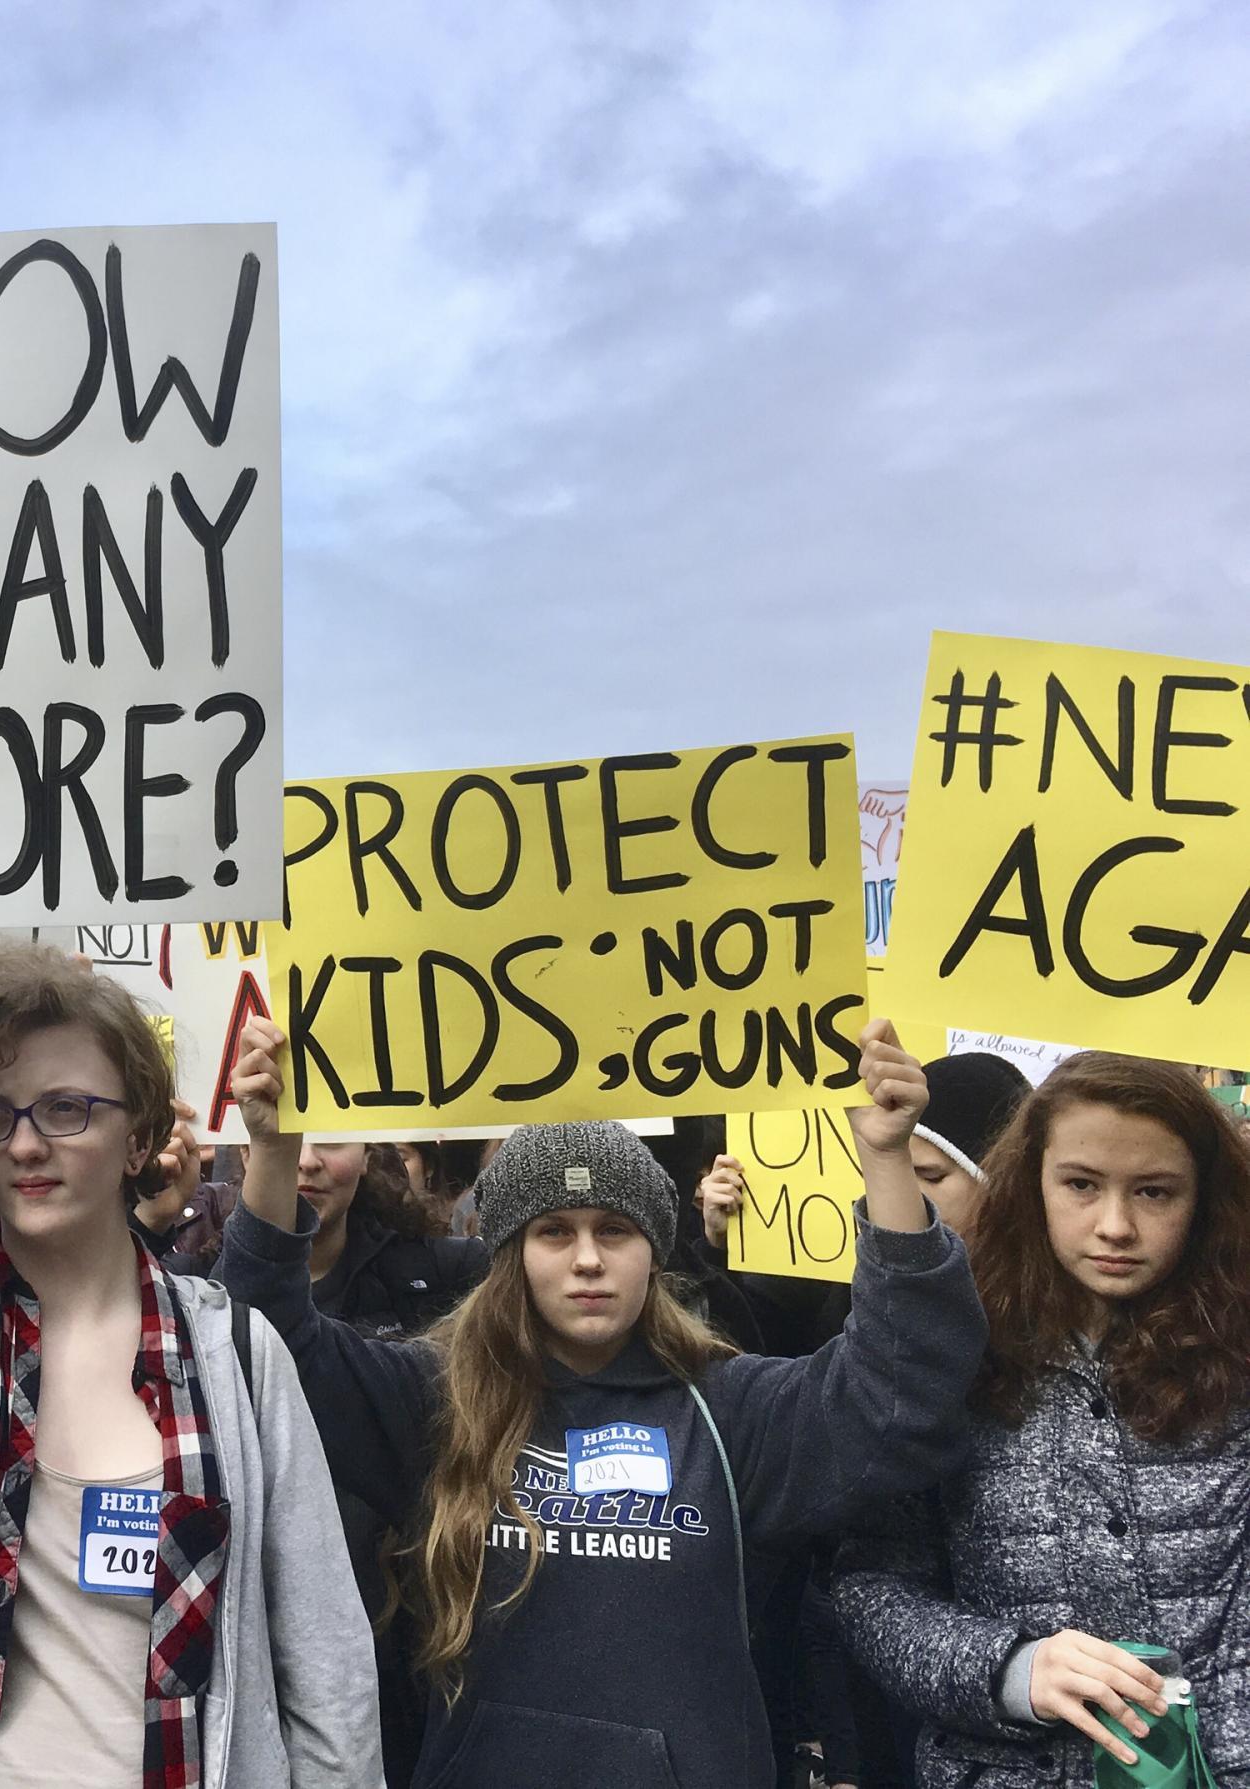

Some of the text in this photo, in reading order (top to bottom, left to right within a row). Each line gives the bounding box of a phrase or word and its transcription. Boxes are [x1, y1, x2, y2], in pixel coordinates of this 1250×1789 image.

[929, 666, 1250, 818] #NE
[283, 742, 851, 931] PROTECT
[642, 900, 835, 997] NOT
[633, 994, 865, 1097] GUNS
[975, 1035, 1046, 1062] allowed
[749, 1108, 865, 1178] ON
[737, 1173, 858, 1266] MO
[581, 1442, 655, 1458] I'm voting in
[582, 1426, 651, 1447] HELLO
[583, 1459, 631, 1485] 2021
[99, 1492, 160, 1514] HELL
[496, 1488, 709, 1536] eattle
[96, 1515, 159, 1532] I'm votin
[102, 1546, 156, 1575] 202
[485, 1524, 672, 1561] ITTE LEAGUE
